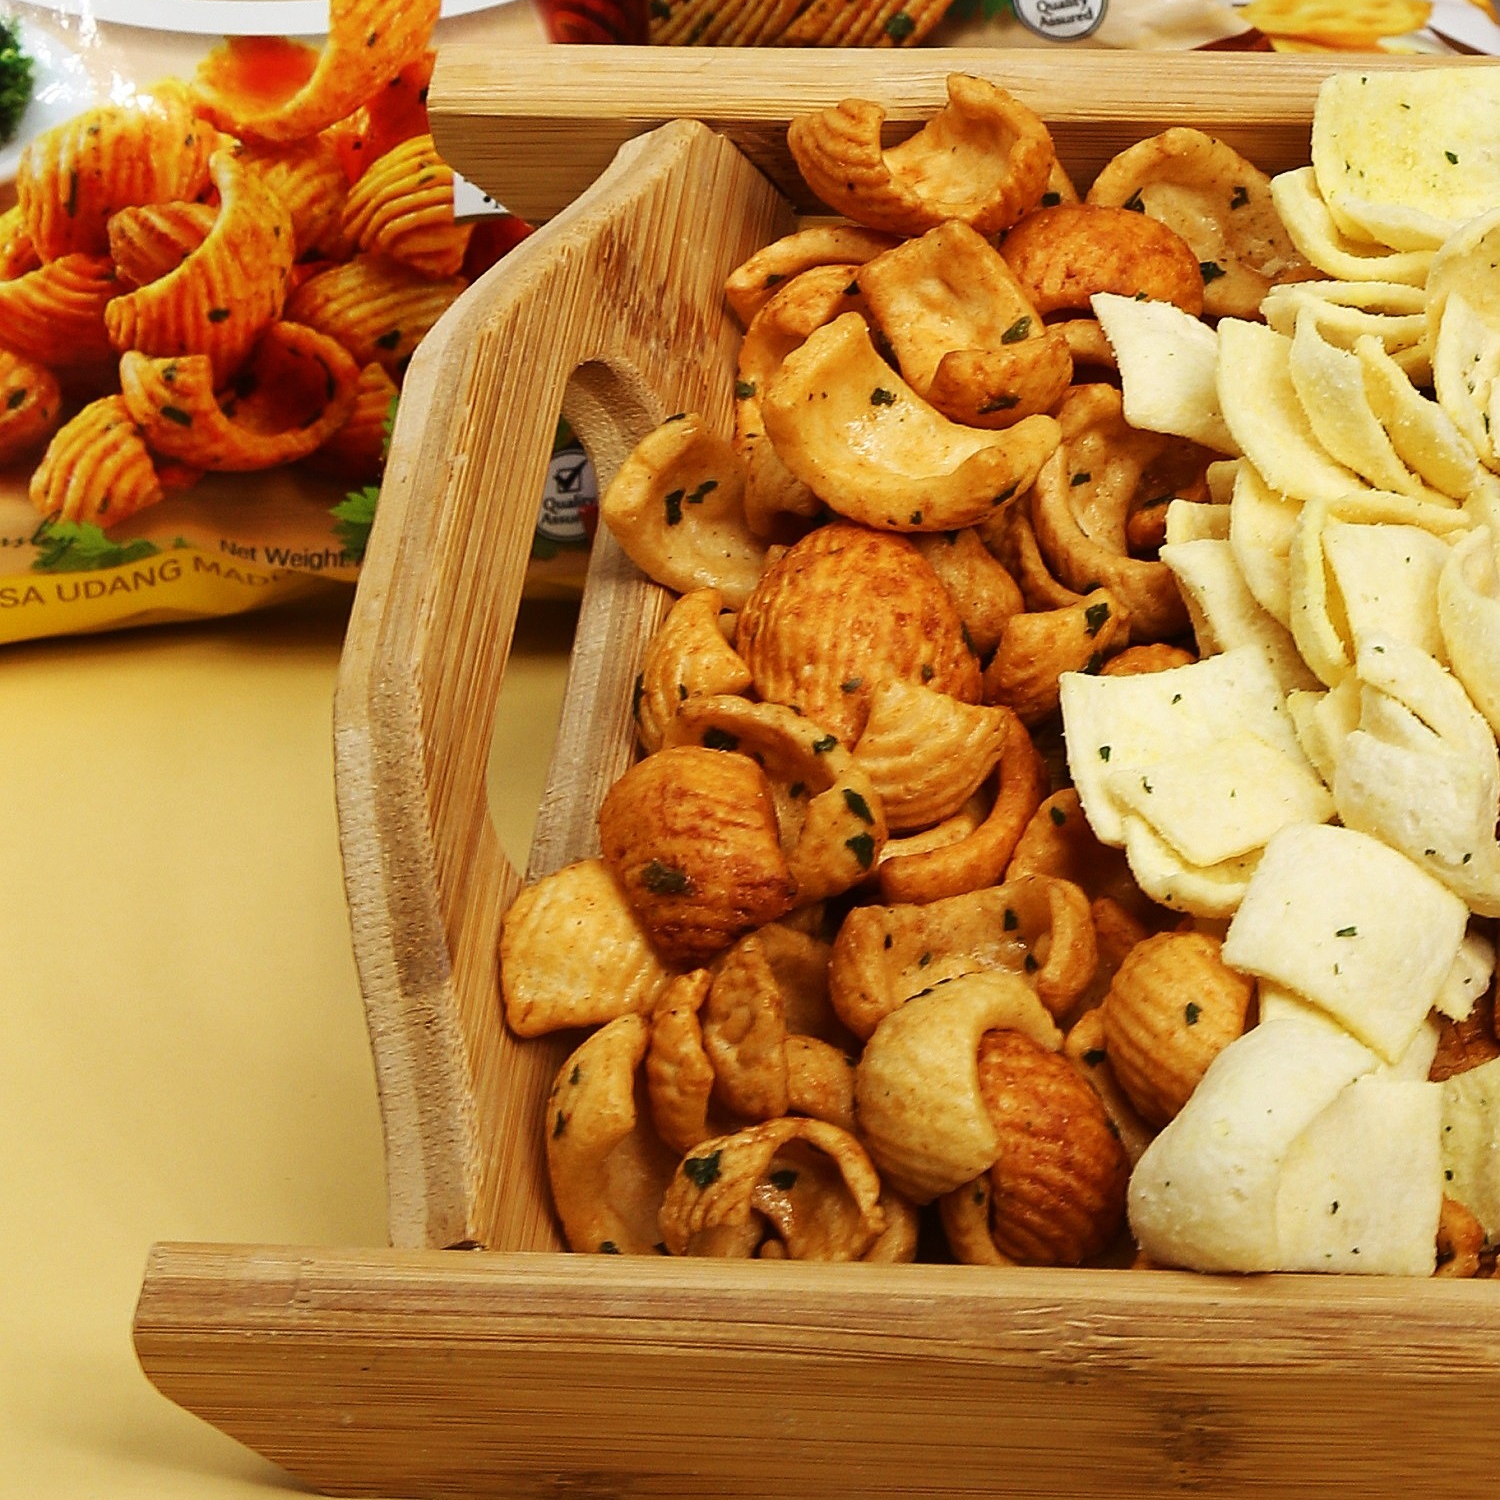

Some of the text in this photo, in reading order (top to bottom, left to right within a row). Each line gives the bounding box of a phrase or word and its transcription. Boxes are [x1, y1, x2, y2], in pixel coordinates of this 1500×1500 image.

[219, 536, 346, 571] Net Weight
[55, 558, 182, 602] UDANG
